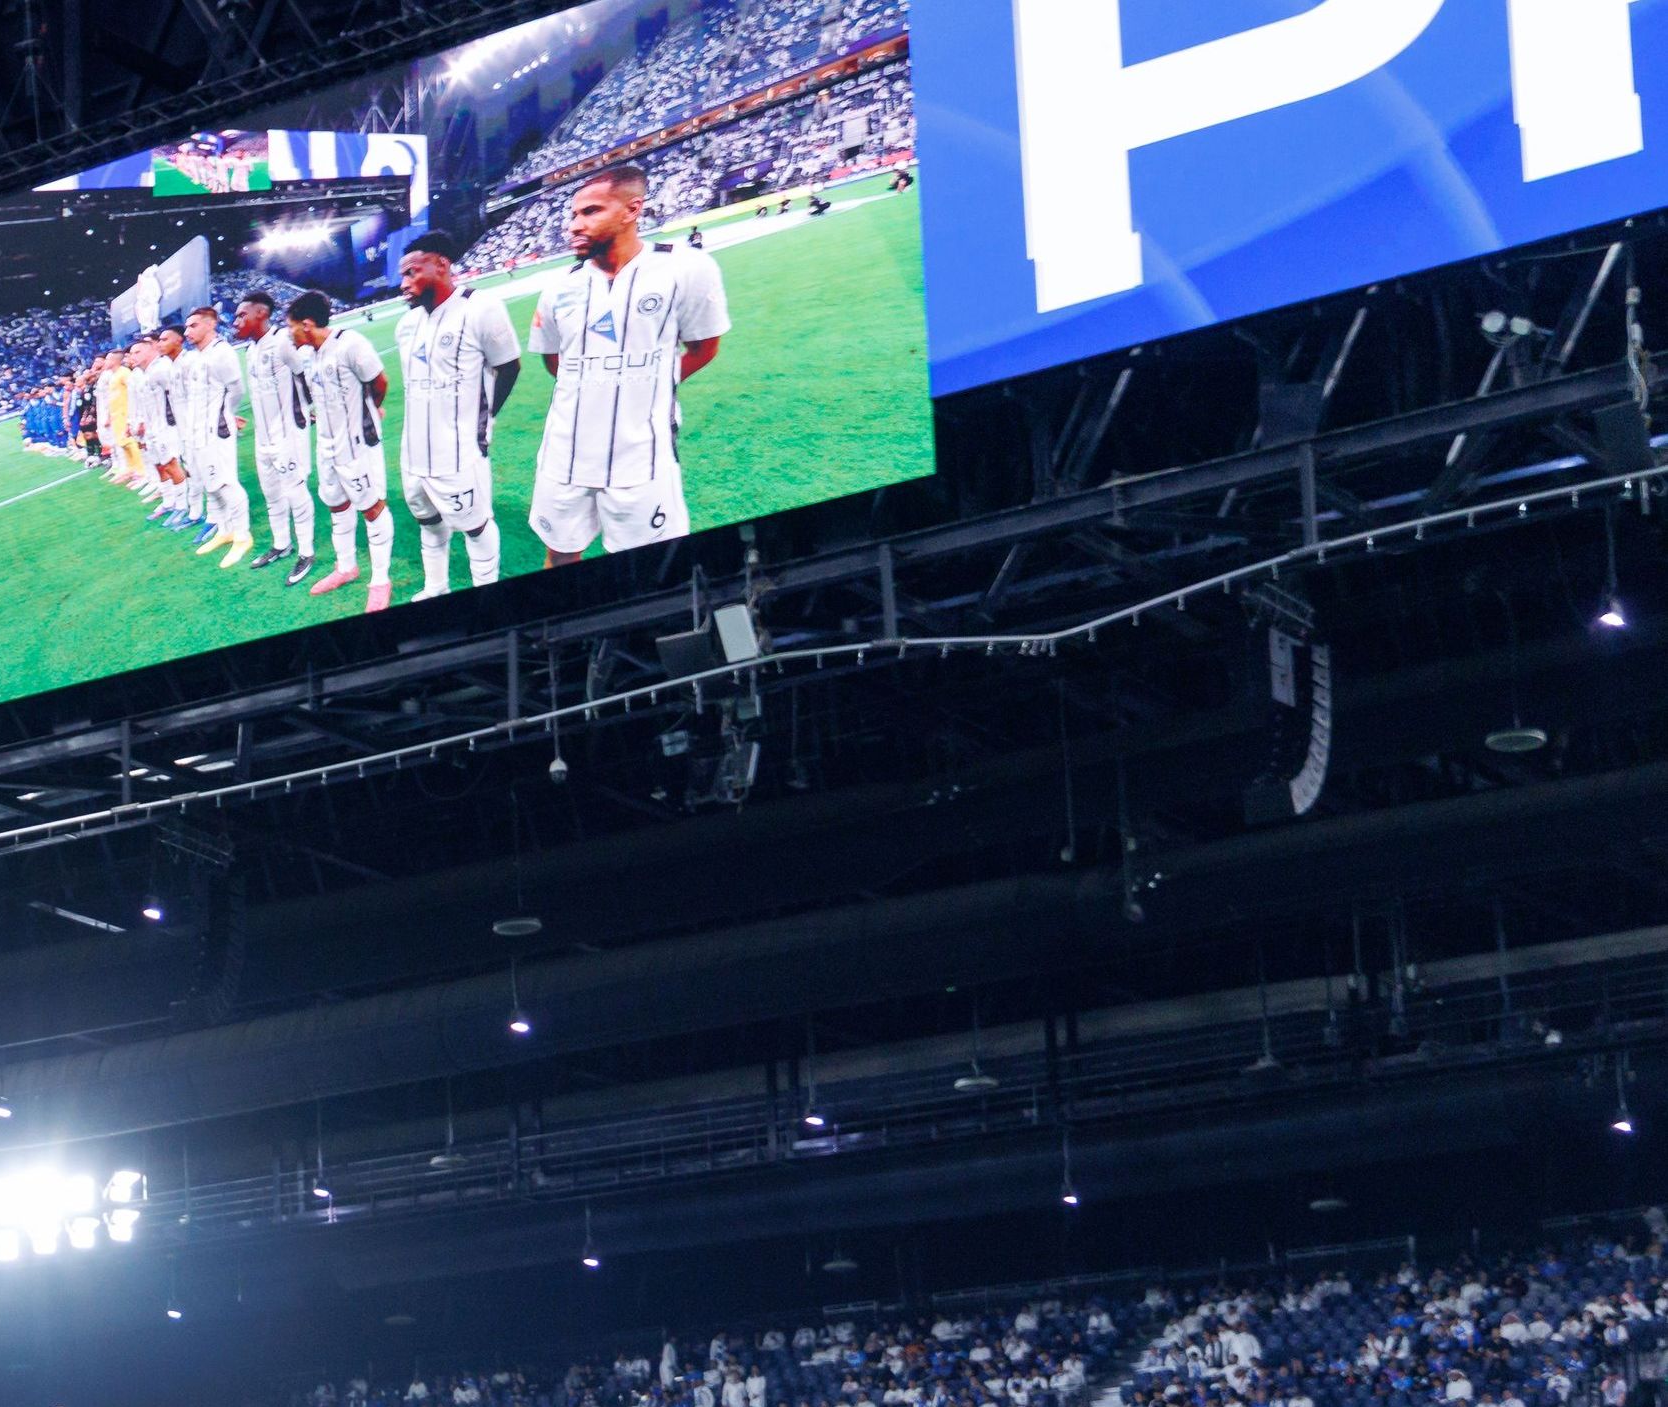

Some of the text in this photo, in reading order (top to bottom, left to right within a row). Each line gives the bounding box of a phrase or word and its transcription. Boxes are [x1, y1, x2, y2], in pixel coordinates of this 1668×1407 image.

[351, 473, 371, 492] 31
[450, 489, 475, 512] 37
[649, 505, 666, 529] 6
